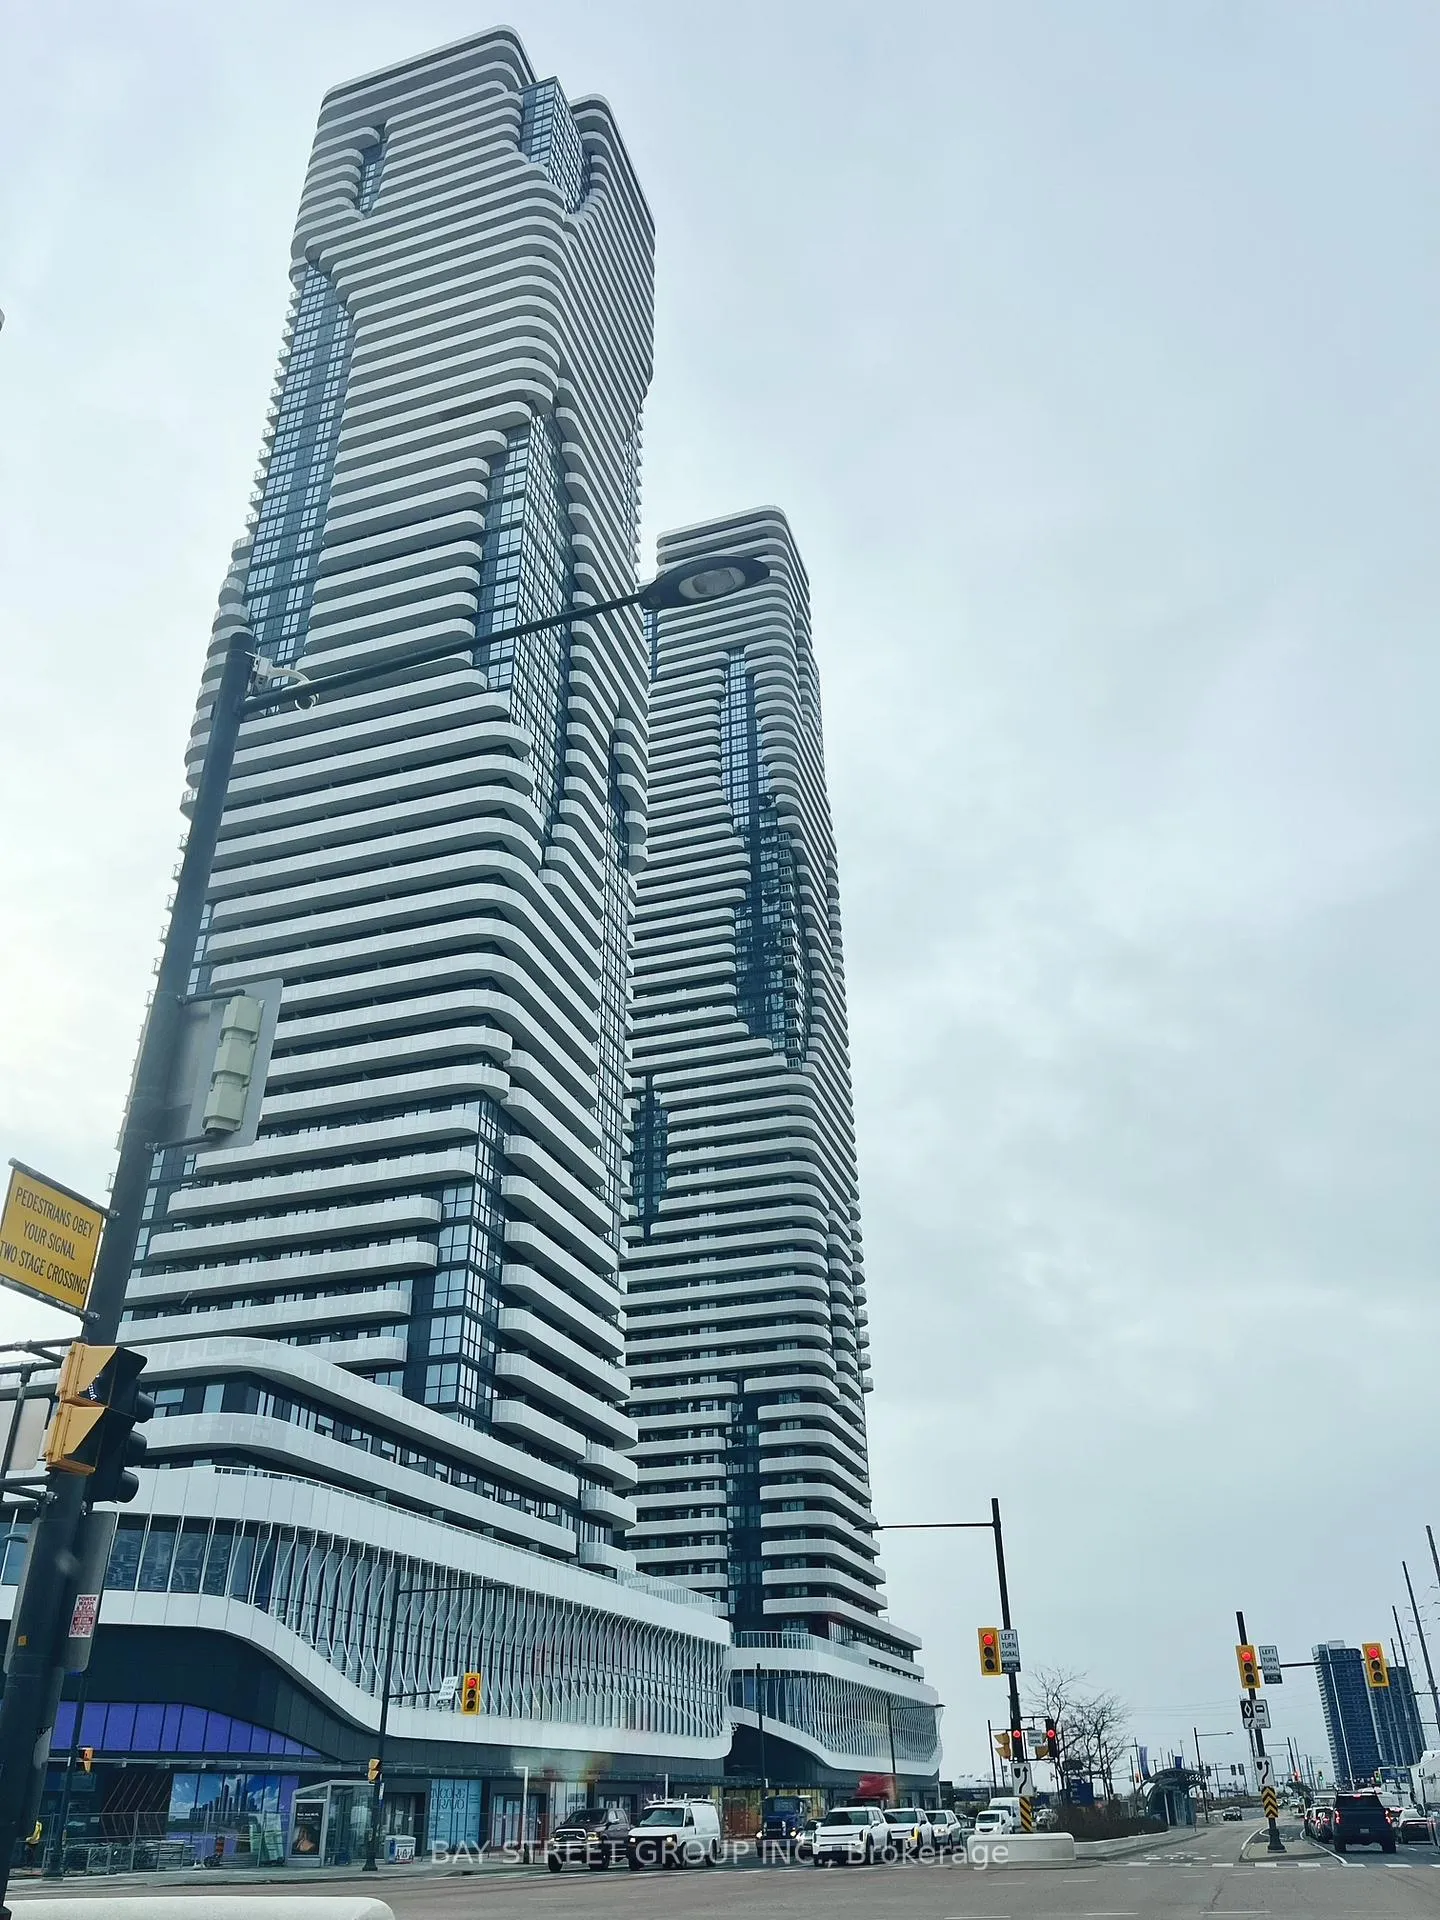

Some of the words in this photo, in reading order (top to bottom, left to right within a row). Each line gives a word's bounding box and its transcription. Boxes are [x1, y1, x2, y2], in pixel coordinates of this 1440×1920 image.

[15, 1187, 72, 1228] PEDESTRIANS
[72, 1215, 95, 1239] OBEY
[23, 1220, 47, 1246] YOUR
[47, 1233, 76, 1261] SIGNAL
[0, 1240, 17, 1263] TWO
[18, 1250, 47, 1277] STAGE
[46, 1263, 87, 1295] CROSSING
